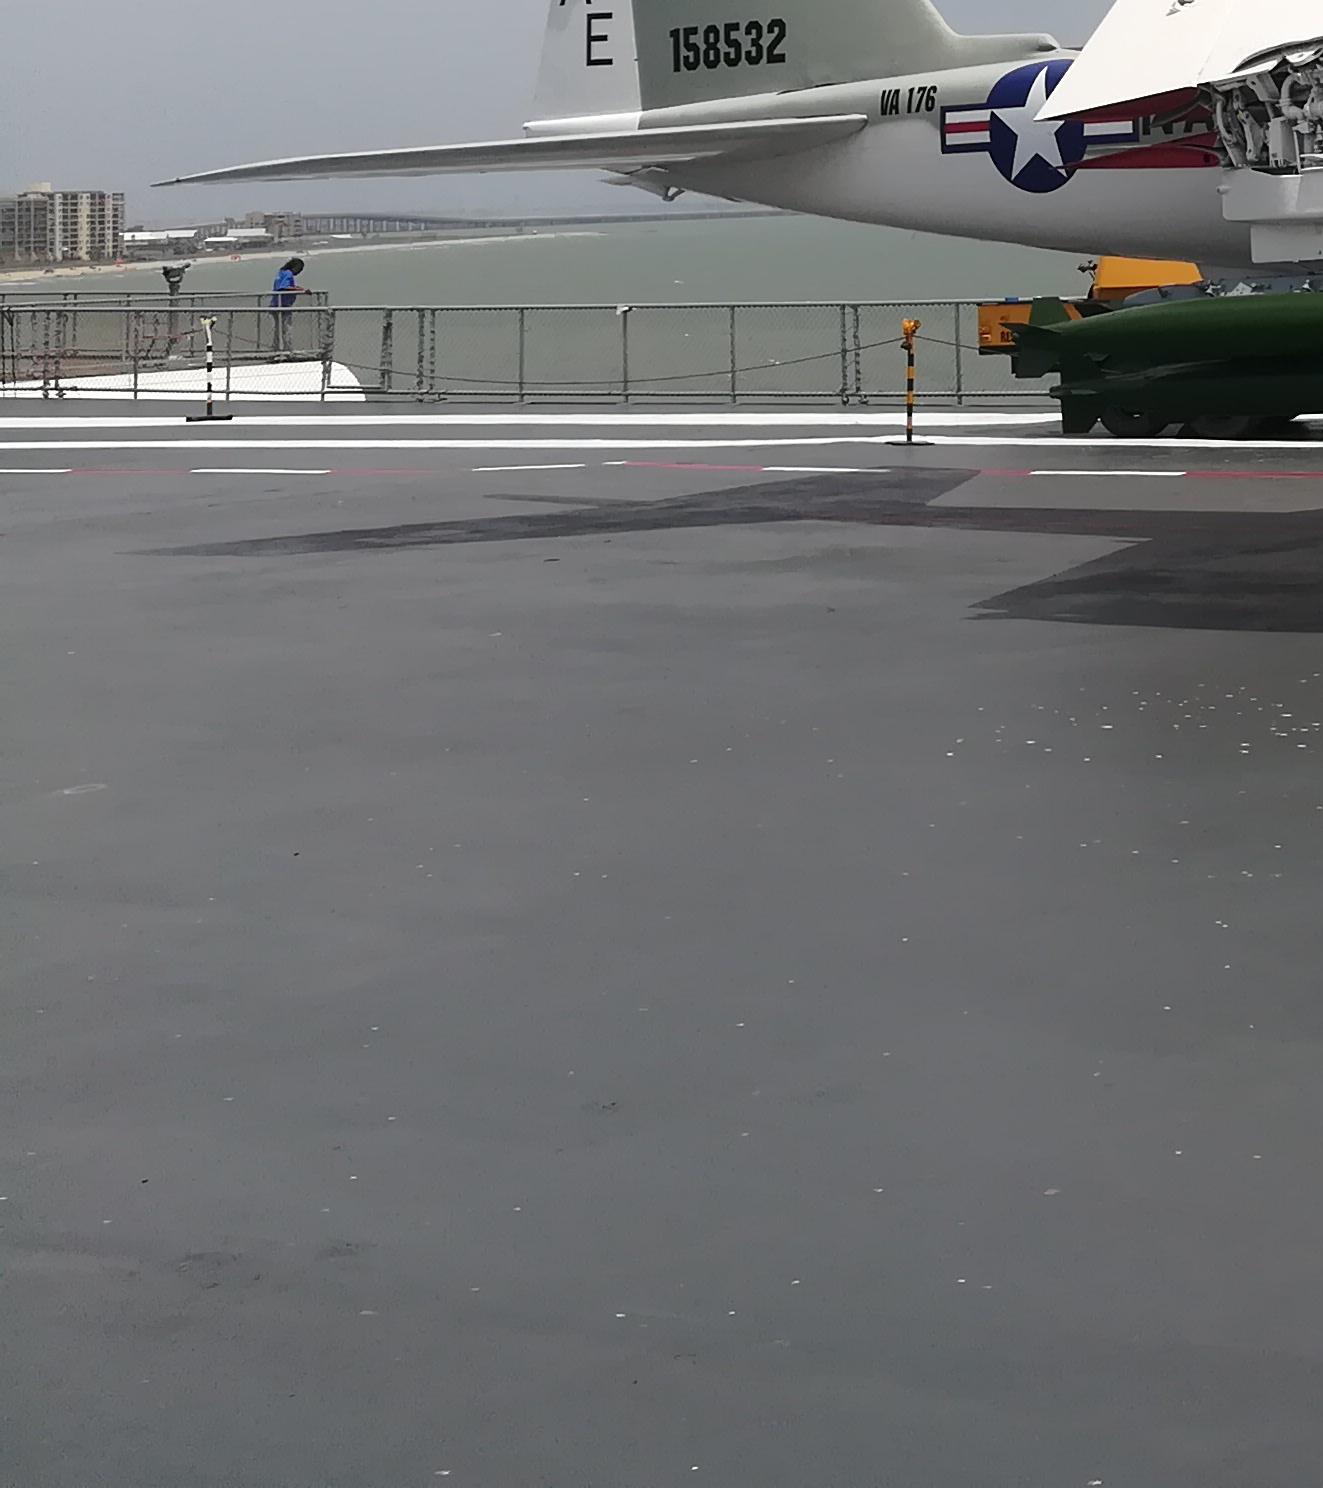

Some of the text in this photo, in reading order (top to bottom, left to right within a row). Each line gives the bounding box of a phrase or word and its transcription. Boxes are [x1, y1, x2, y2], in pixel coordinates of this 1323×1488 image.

[586, 12, 614, 66] E
[669, 18, 787, 73] 158532
[881, 85, 938, 116] VA 176
